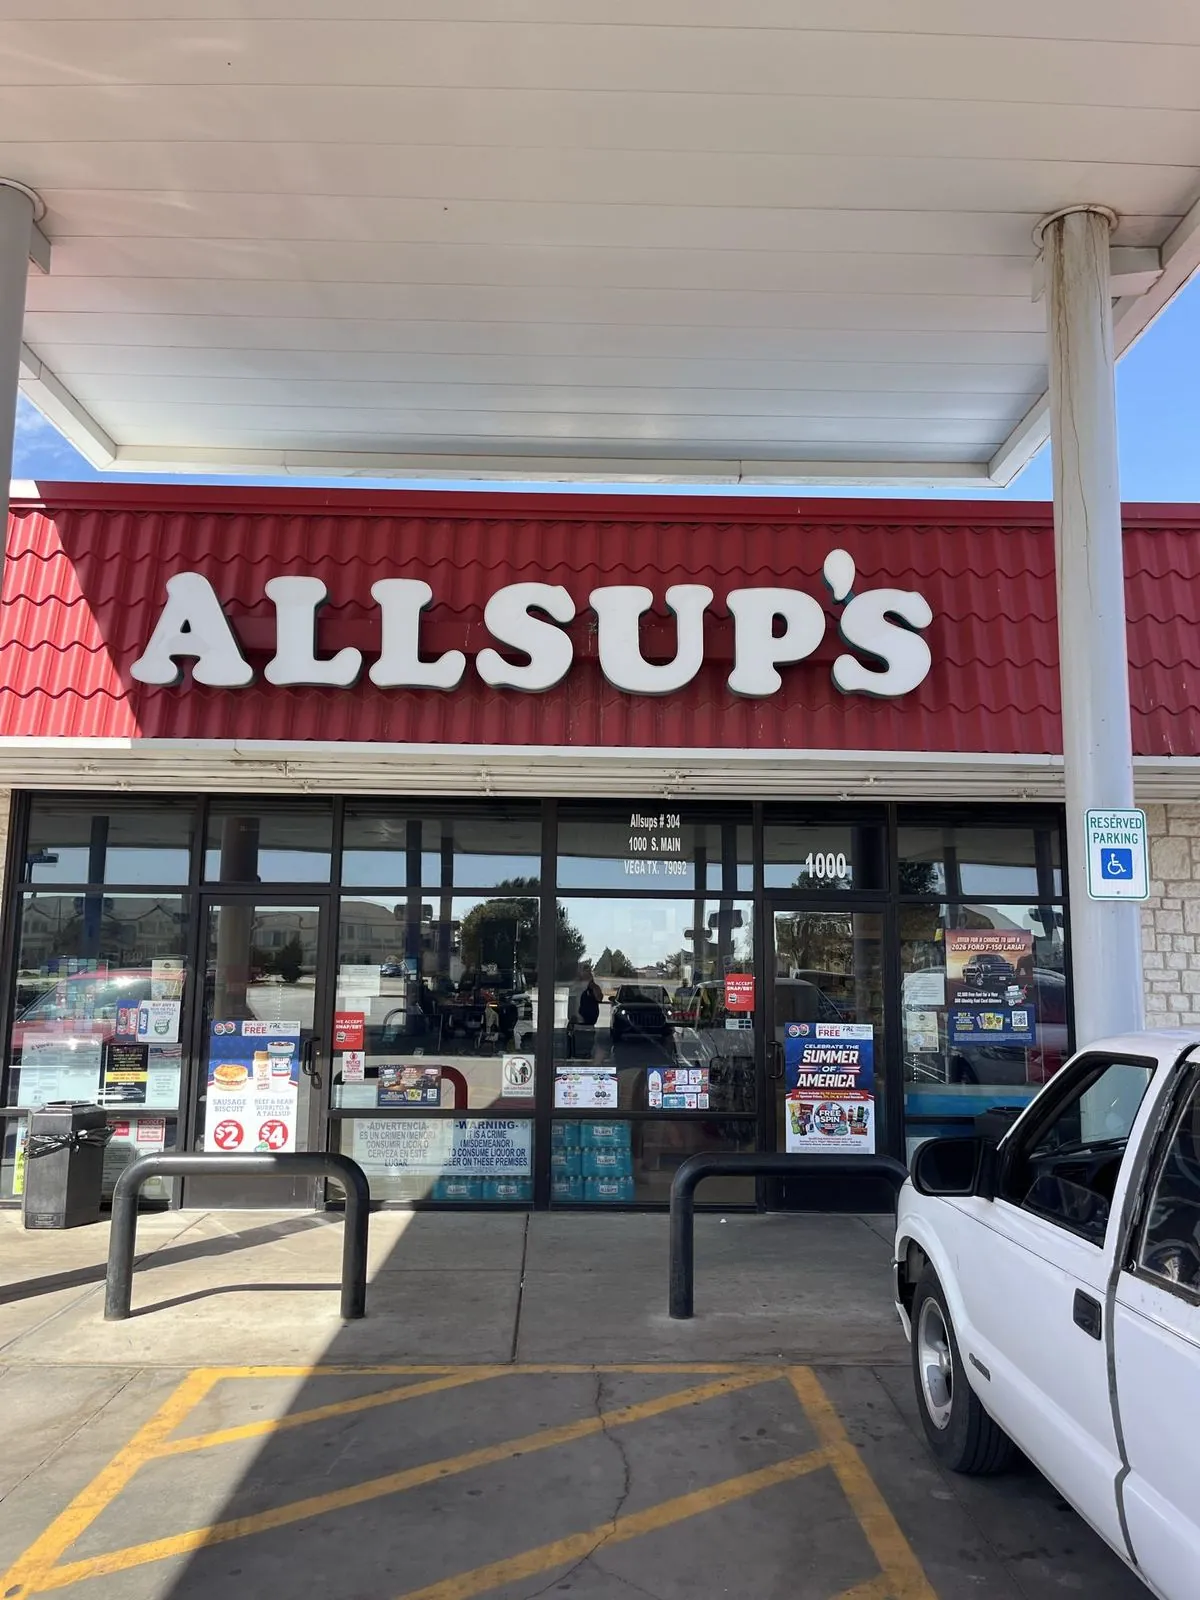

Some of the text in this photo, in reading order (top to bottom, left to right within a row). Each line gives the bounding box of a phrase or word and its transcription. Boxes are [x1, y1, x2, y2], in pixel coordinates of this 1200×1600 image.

[130, 549, 934, 698] ALLSUP'S
[630, 814, 680, 831] Allsups # 304
[1090, 817, 1142, 829] RESERVED
[628, 836, 680, 852] 1000 S. MAIN
[1093, 832, 1138, 844] PARKING
[624, 860, 686, 875] VEGA TX. 79092
[805, 852, 846, 878] 1000
[802, 1050, 859, 1064] SUMMER
[797, 1074, 856, 1088] AMERICA
[367, 1122, 429, 1130] -ADVERTENCIA-
[455, 1121, 518, 1129] -WARNING-
[215, 1125, 240, 1147] $2
[261, 1125, 285, 1147] $4
[359, 1132, 368, 1140] ES
[370, 1132, 379, 1140] UN
[381, 1132, 405, 1140] CRIMEN
[467, 1130, 507, 1138] IT IS A CRIME
[366, 1141, 400, 1149] CONSUMIR
[402, 1141, 422, 1149] LICOR
[460, 1139, 514, 1148] (MISDEMEANOR)
[368, 1150, 427, 1158] CERVEZA EN ESTE
[457, 1149, 489, 1157] CONSUME
[491, 1149, 515, 1157] LIQUOR
[516, 1149, 526, 1157] OR
[462, 1158, 472, 1166] ON
[473, 1158, 494, 1166] THESE
